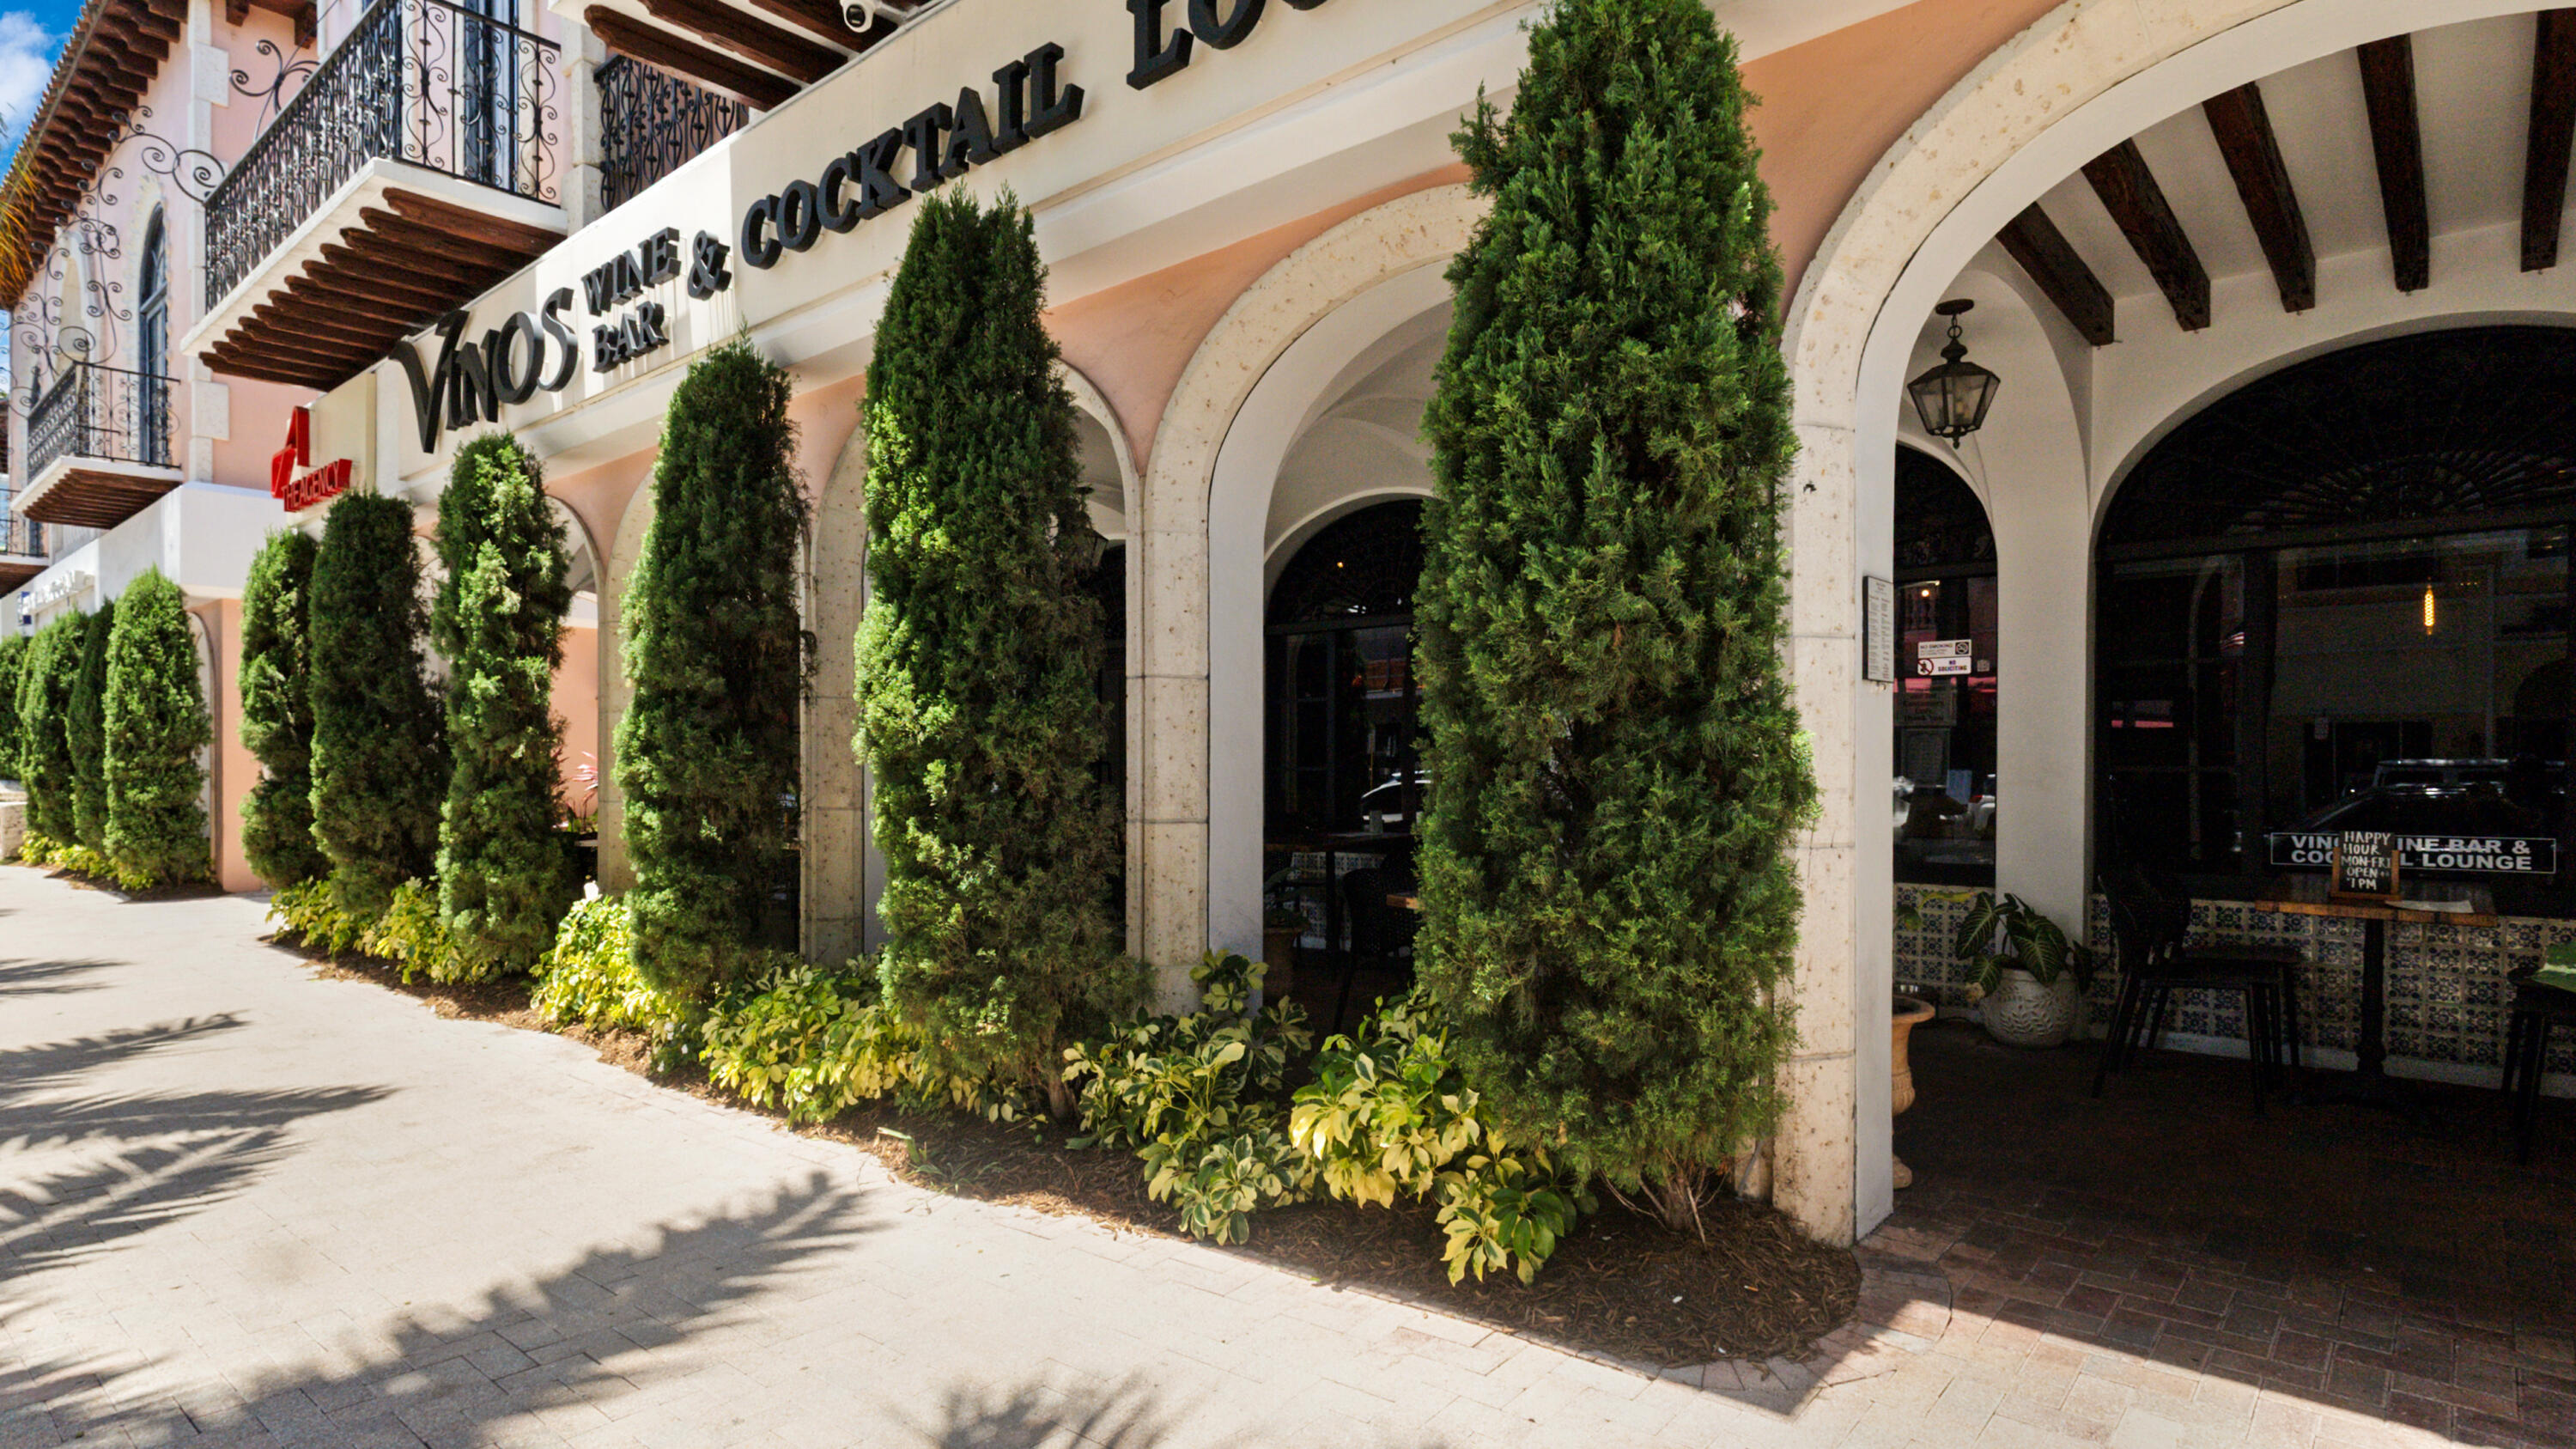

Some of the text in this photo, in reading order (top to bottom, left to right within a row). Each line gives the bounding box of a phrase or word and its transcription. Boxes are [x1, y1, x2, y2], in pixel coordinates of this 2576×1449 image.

[581, 227, 681, 316] WINE
[687, 229, 732, 301] &
[742, 42, 1084, 268] COCKTAIL
[592, 301, 670, 374] BAR
[388, 287, 577, 454] VINOS
[2291, 835, 2532, 855] VIN INE BAR &
[2344, 831, 2391, 845] HAPPY
[2342, 843, 2382, 855] HOUR
[2421, 853, 2532, 870] LOUNGE
[2347, 867, 2378, 878] OPEN
